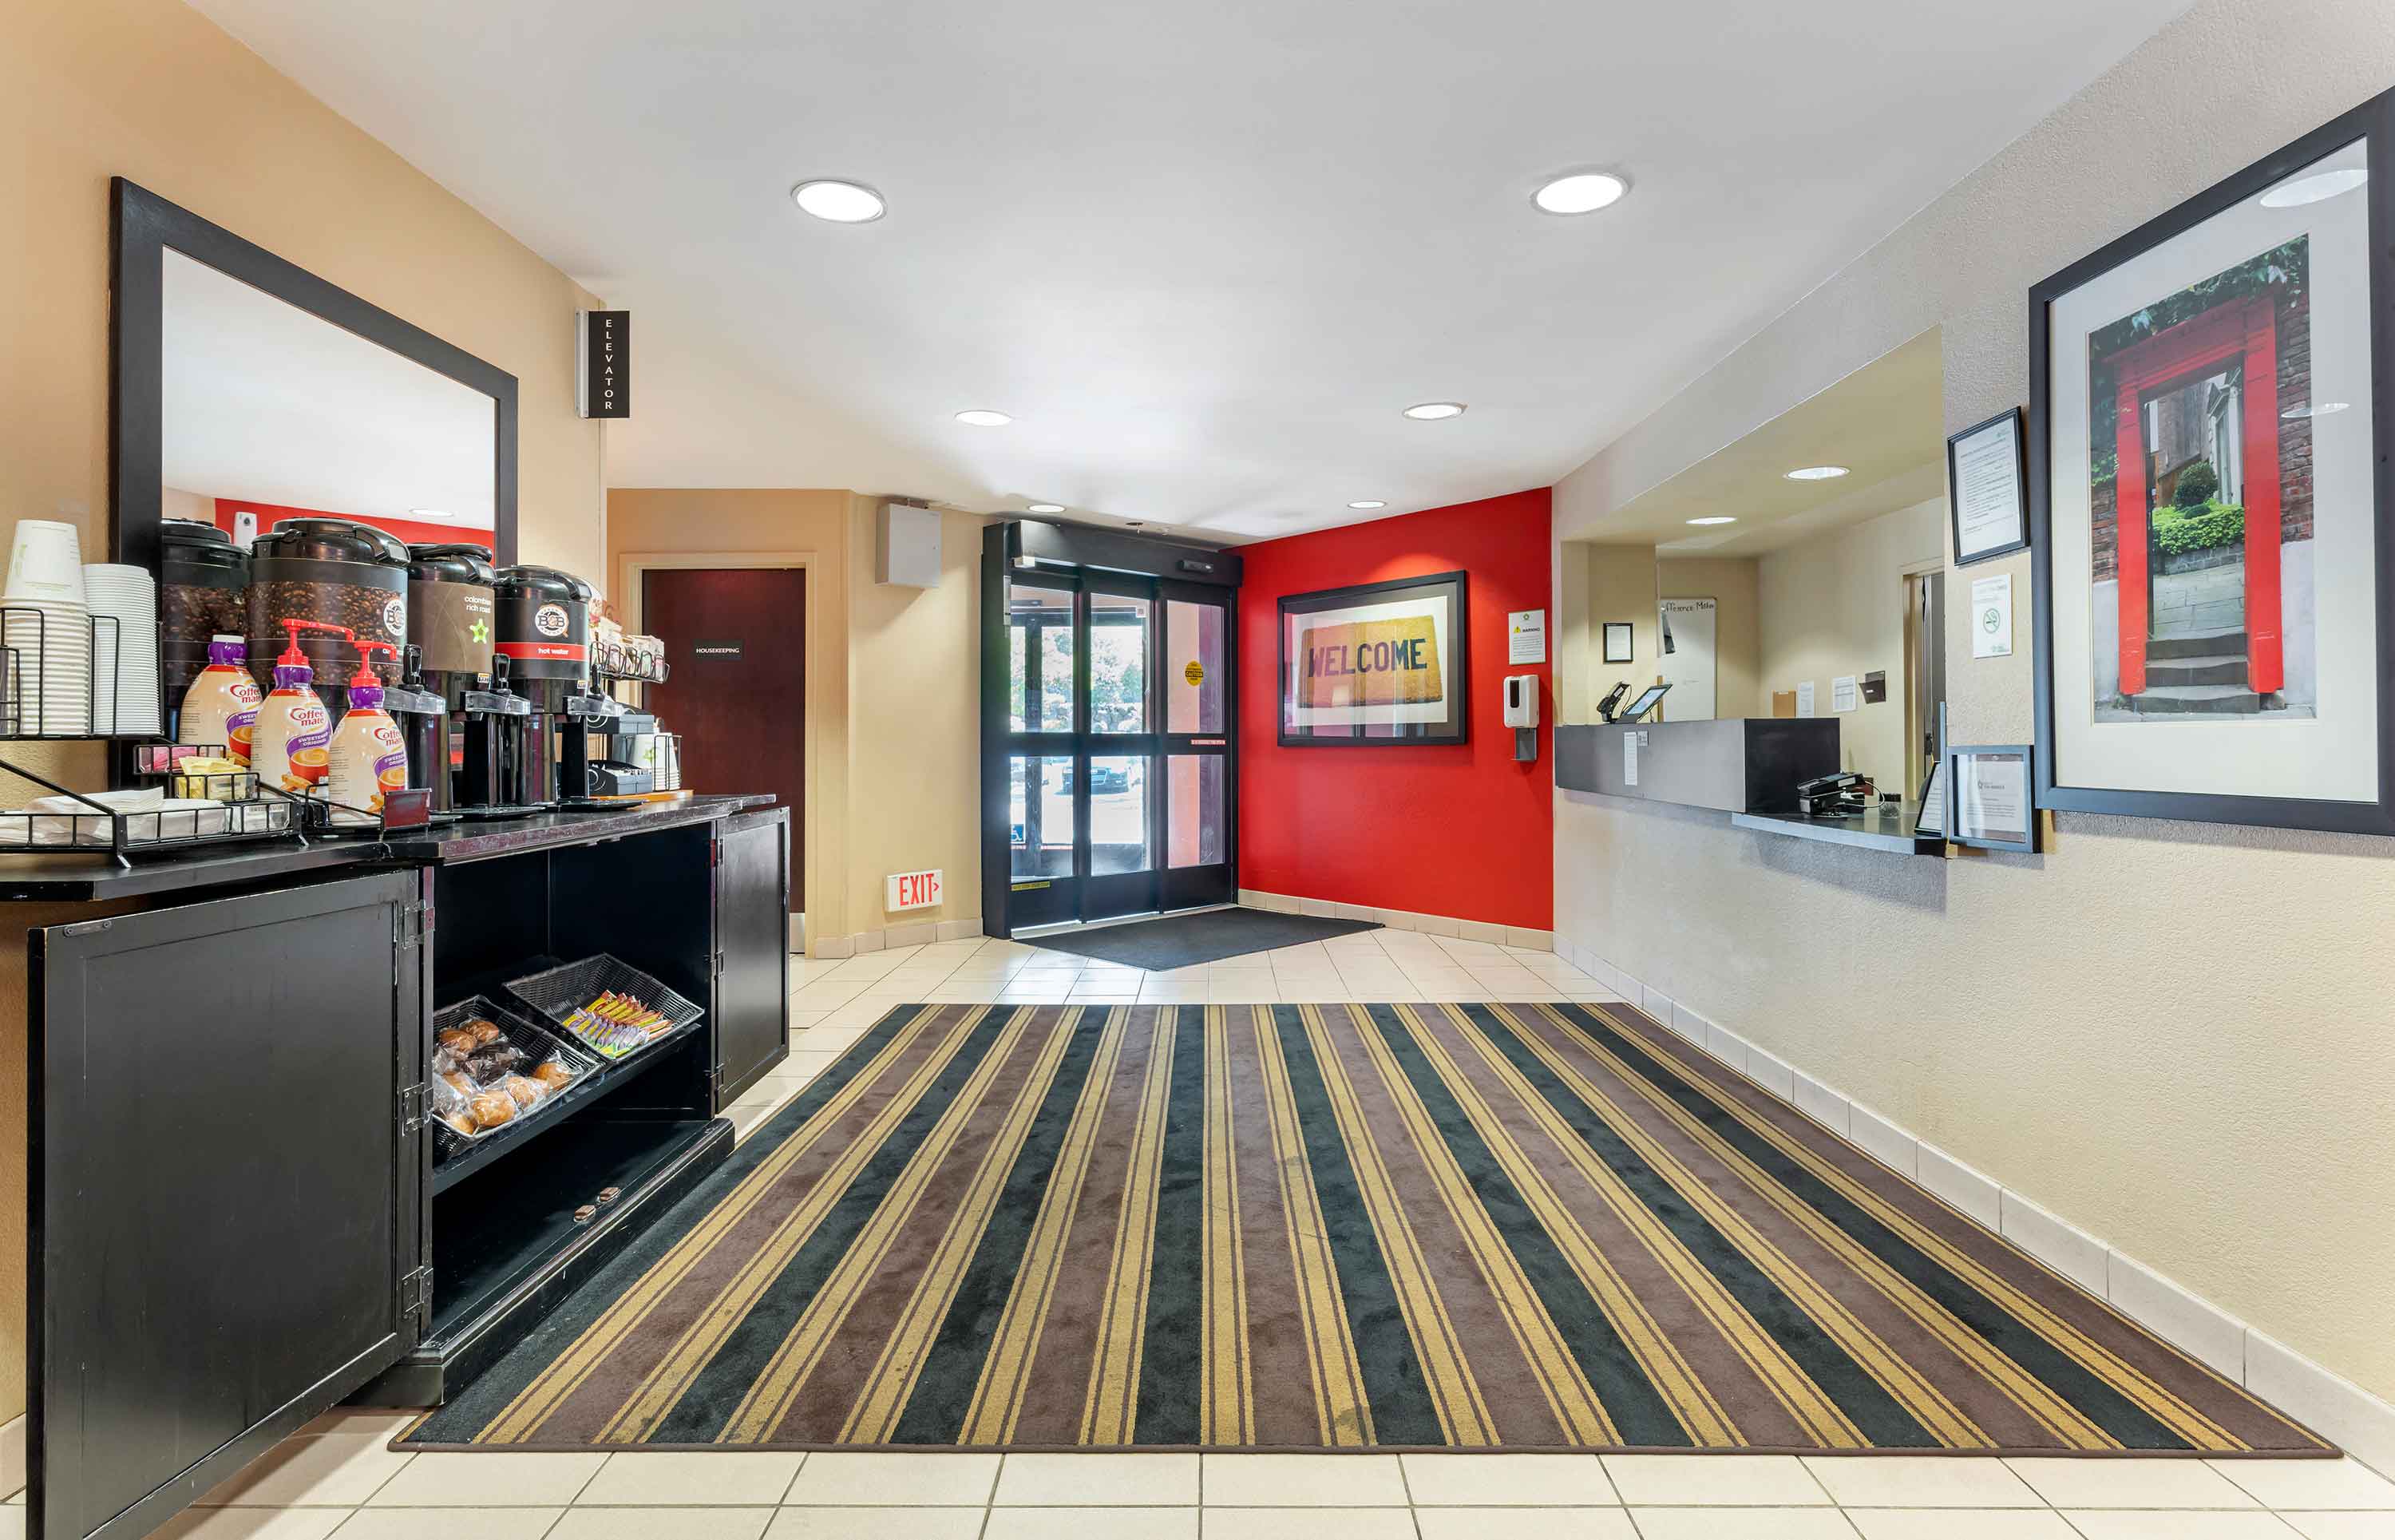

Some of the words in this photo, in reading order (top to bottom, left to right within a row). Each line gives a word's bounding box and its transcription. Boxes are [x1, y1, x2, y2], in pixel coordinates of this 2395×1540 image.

[604, 319, 614, 410] ELEVATOR
[1308, 639, 1428, 678] WELCOME
[290, 707, 326, 722] Coffee
[300, 718, 326, 727] mate
[899, 873, 935, 906] EXIT
